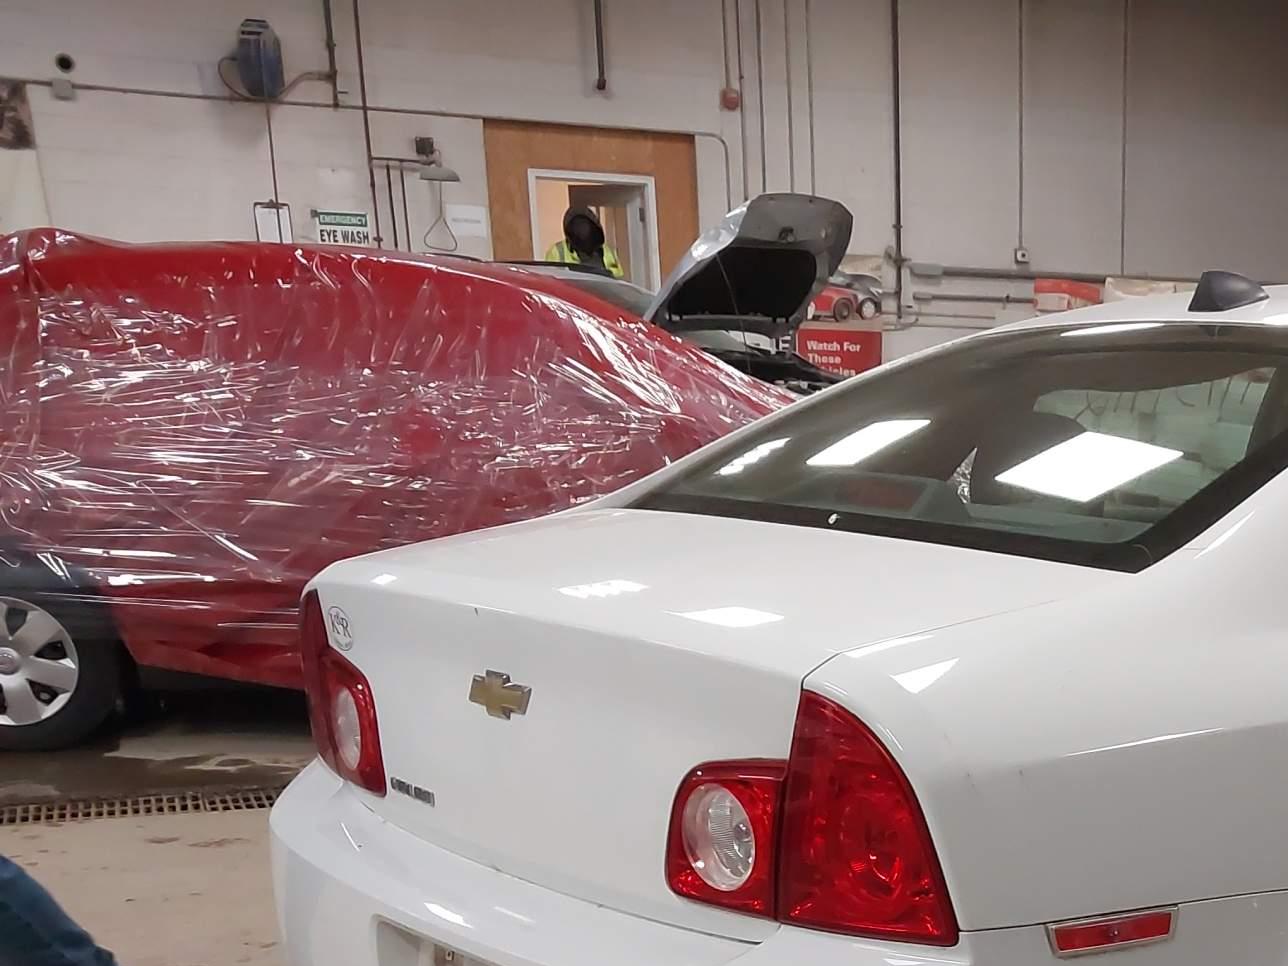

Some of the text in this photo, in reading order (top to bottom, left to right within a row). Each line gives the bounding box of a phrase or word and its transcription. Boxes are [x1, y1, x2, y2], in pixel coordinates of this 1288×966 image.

[320, 214, 367, 226] EMERGENCY
[320, 229, 370, 245] EYE WASH
[806, 340, 861, 352] Watch For
[807, 353, 842, 365] These
